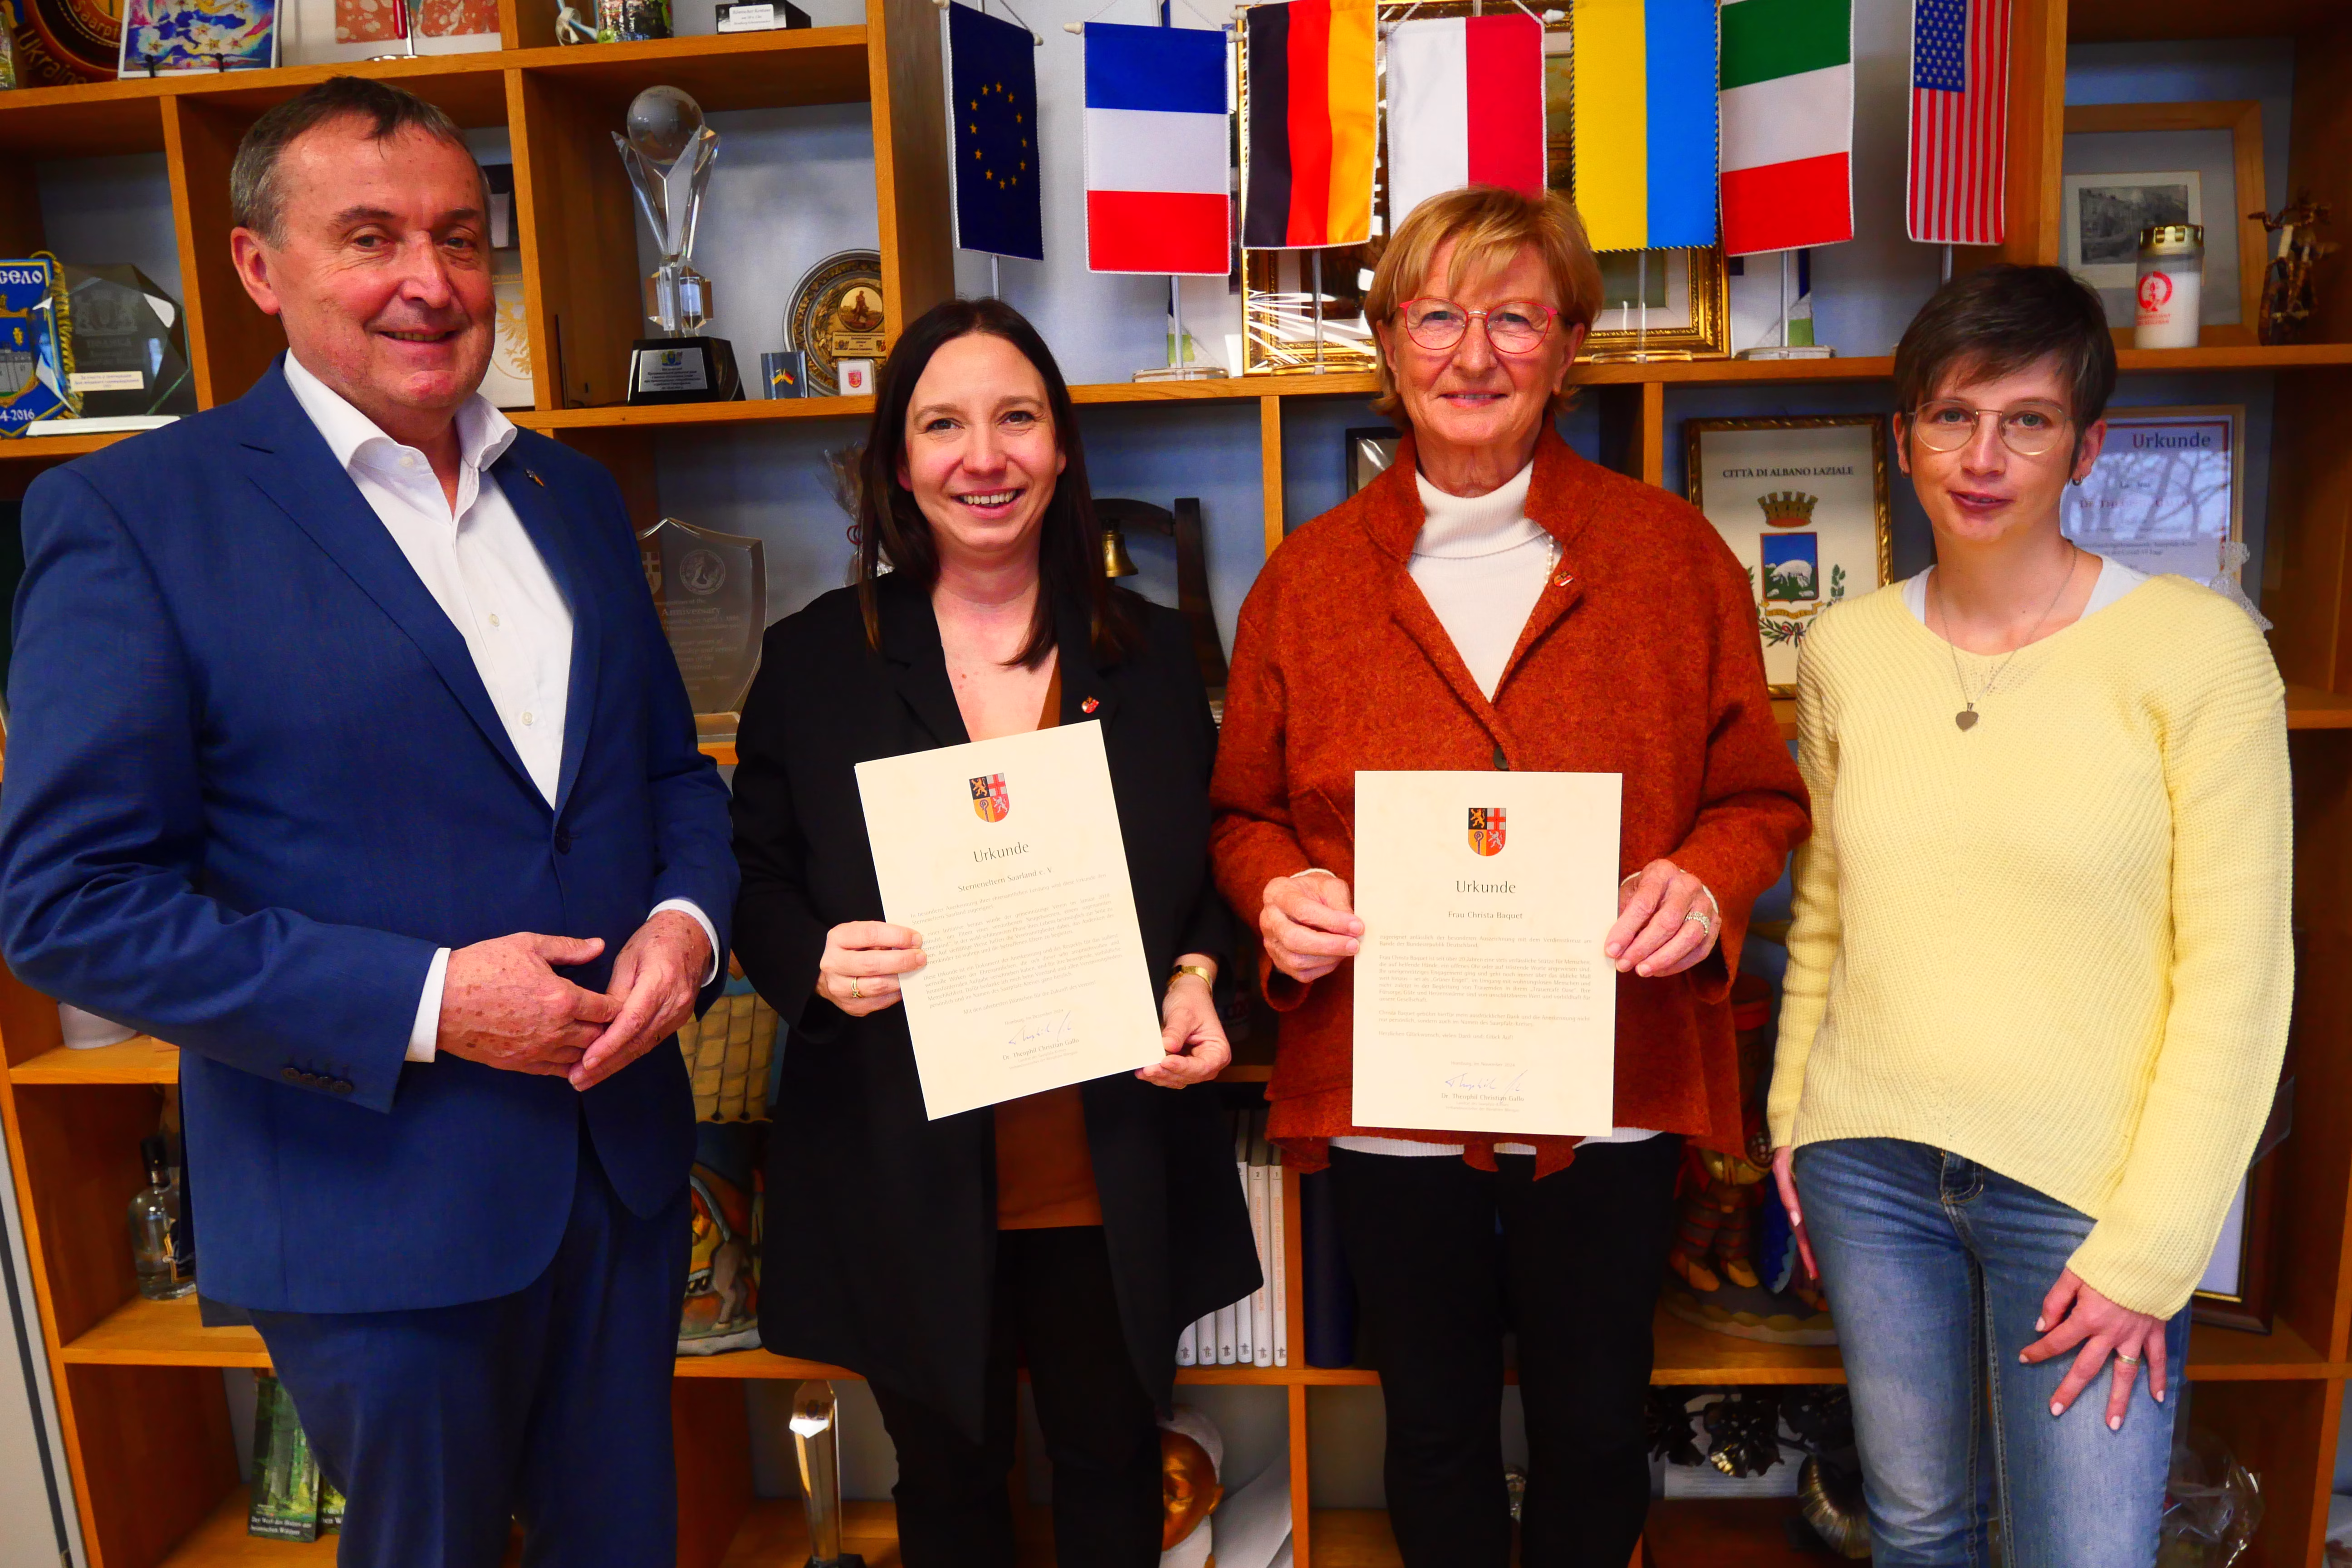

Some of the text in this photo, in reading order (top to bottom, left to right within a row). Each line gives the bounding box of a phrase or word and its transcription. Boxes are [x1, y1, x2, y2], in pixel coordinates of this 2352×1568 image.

[2132, 431, 2210, 448] Urkunde
[1723, 466, 1853, 477] CITTÀ DI ALBANO LAZIALE
[662, 607, 721, 616] Anniversary
[972, 841, 1029, 863] Urkunde
[957, 877, 1005, 892] Sterneneltern
[1006, 869, 1037, 882] Saarland
[1455, 879, 1516, 894] Urkunde
[1447, 910, 1465, 918] Frau
[1496, 911, 1522, 921] Baquet
[1013, 1047, 1037, 1058] Theophil
[1037, 1040, 1063, 1052] Christian
[1064, 1037, 1079, 1045] Gallo
[1451, 1093, 1478, 1101] Theophil
[1479, 1094, 1507, 1102] Christian
